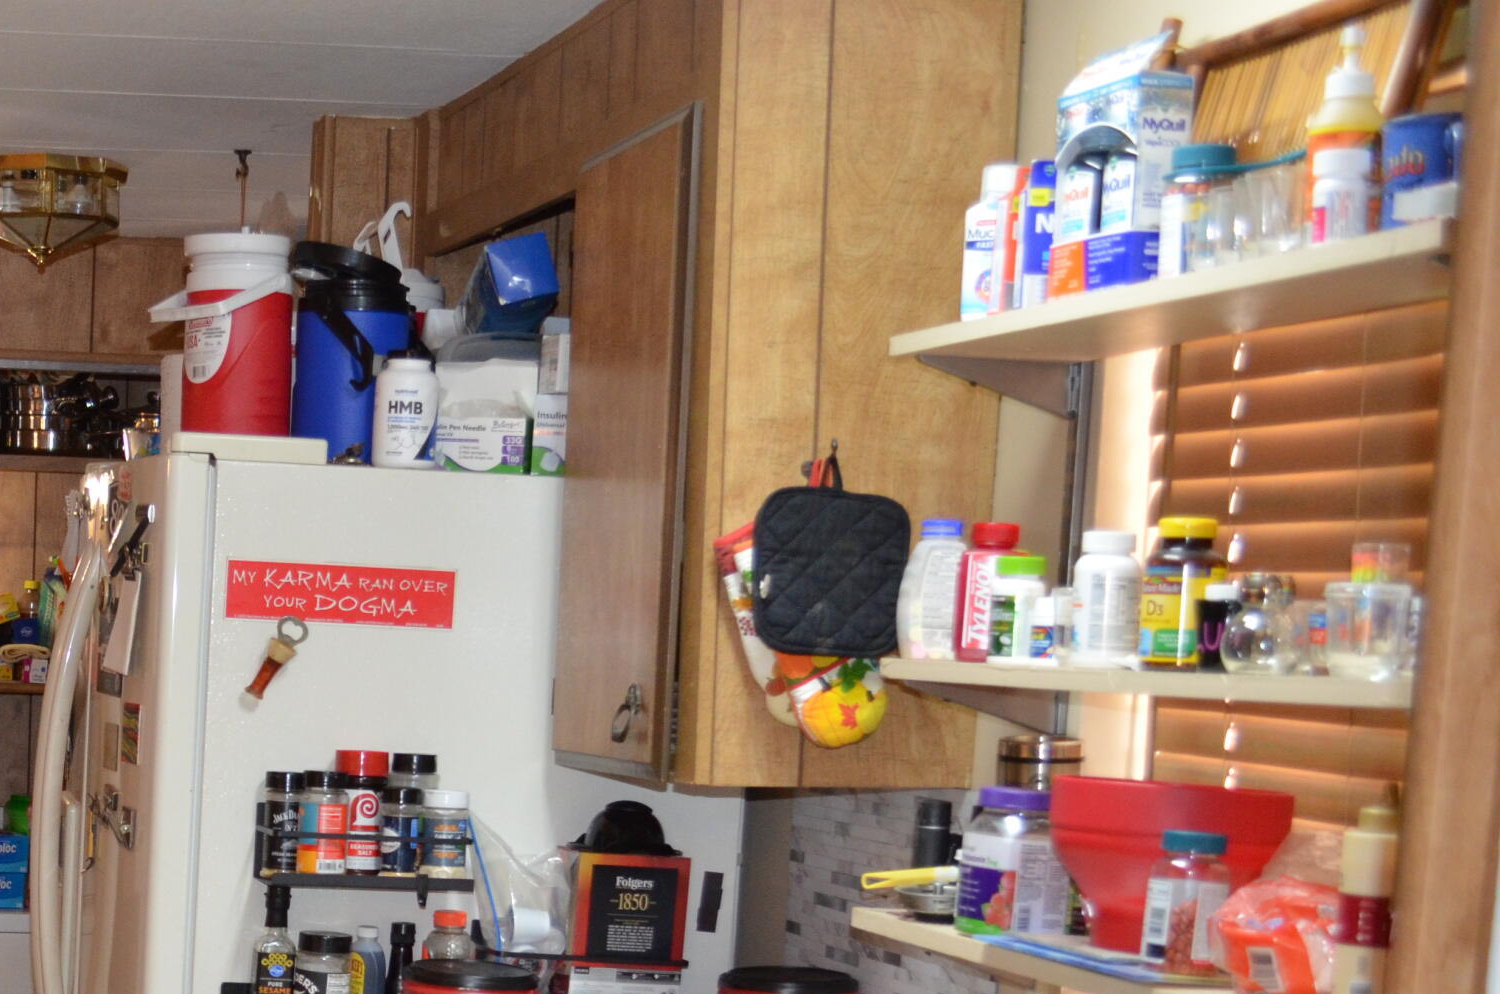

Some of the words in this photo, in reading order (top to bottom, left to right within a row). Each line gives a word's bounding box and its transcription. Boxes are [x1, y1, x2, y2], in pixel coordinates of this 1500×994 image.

[1142, 117, 1186, 134] NyQuil
[967, 229, 994, 240] Muc
[388, 400, 423, 415] HMB
[232, 569, 257, 585] MY
[263, 568, 353, 592] KARMA
[358, 577, 394, 592] RAN
[399, 579, 448, 596] OVER
[263, 595, 307, 612] YOUR
[314, 594, 417, 619] DOGMA
[615, 876, 655, 890] Folgers
[618, 892, 649, 911] 1850
